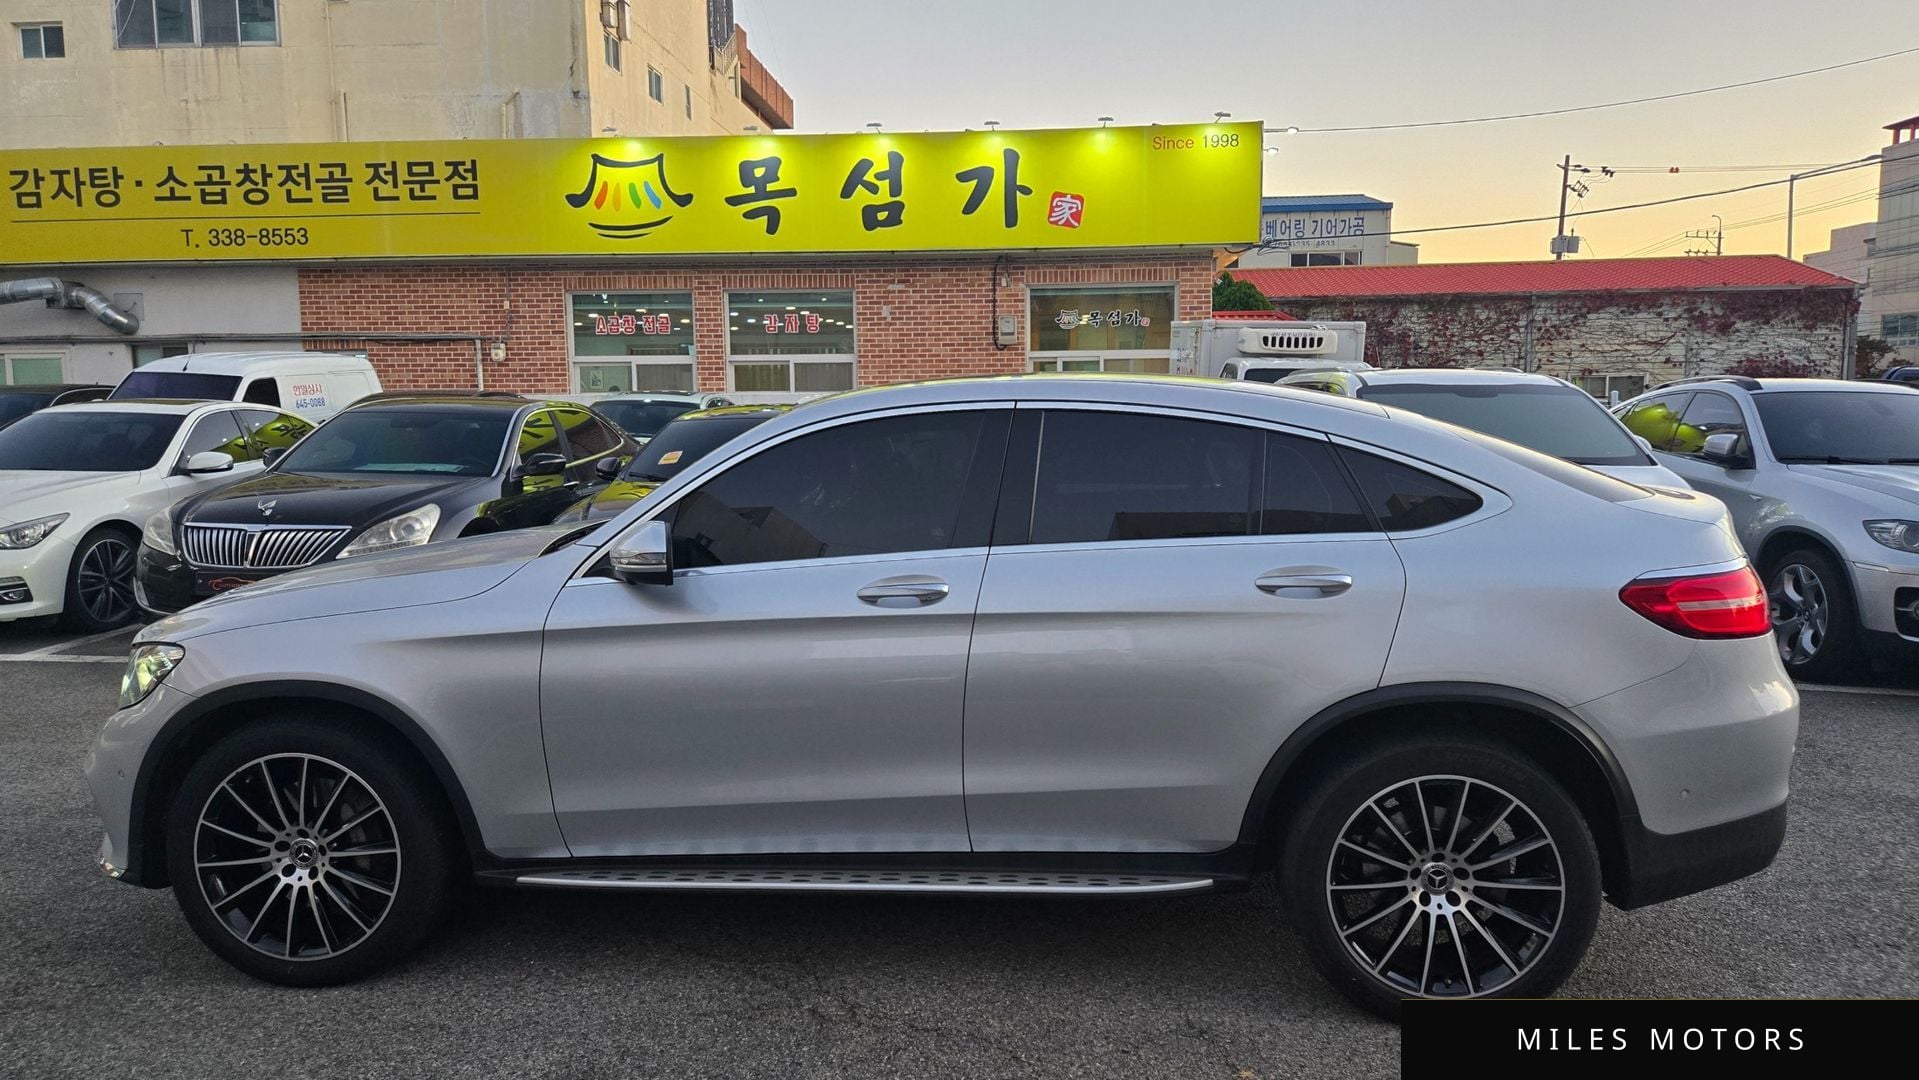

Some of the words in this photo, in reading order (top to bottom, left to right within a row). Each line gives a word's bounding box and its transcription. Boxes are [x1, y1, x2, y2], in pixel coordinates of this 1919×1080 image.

[1152, 135, 1195, 151] Since
[1203, 133, 1240, 149] 1998
[364, 158, 480, 202] 전문점
[1049, 193, 1083, 228] 家
[180, 228, 201, 249] T.
[207, 227, 309, 248] 338-8553
[1265, 218, 1306, 238] 베어링
[1312, 216, 1365, 238] 기어가공
[595, 315, 637, 335] 소곱창
[642, 314, 672, 335] 전골
[295, 397, 326, 409] 645-0088
